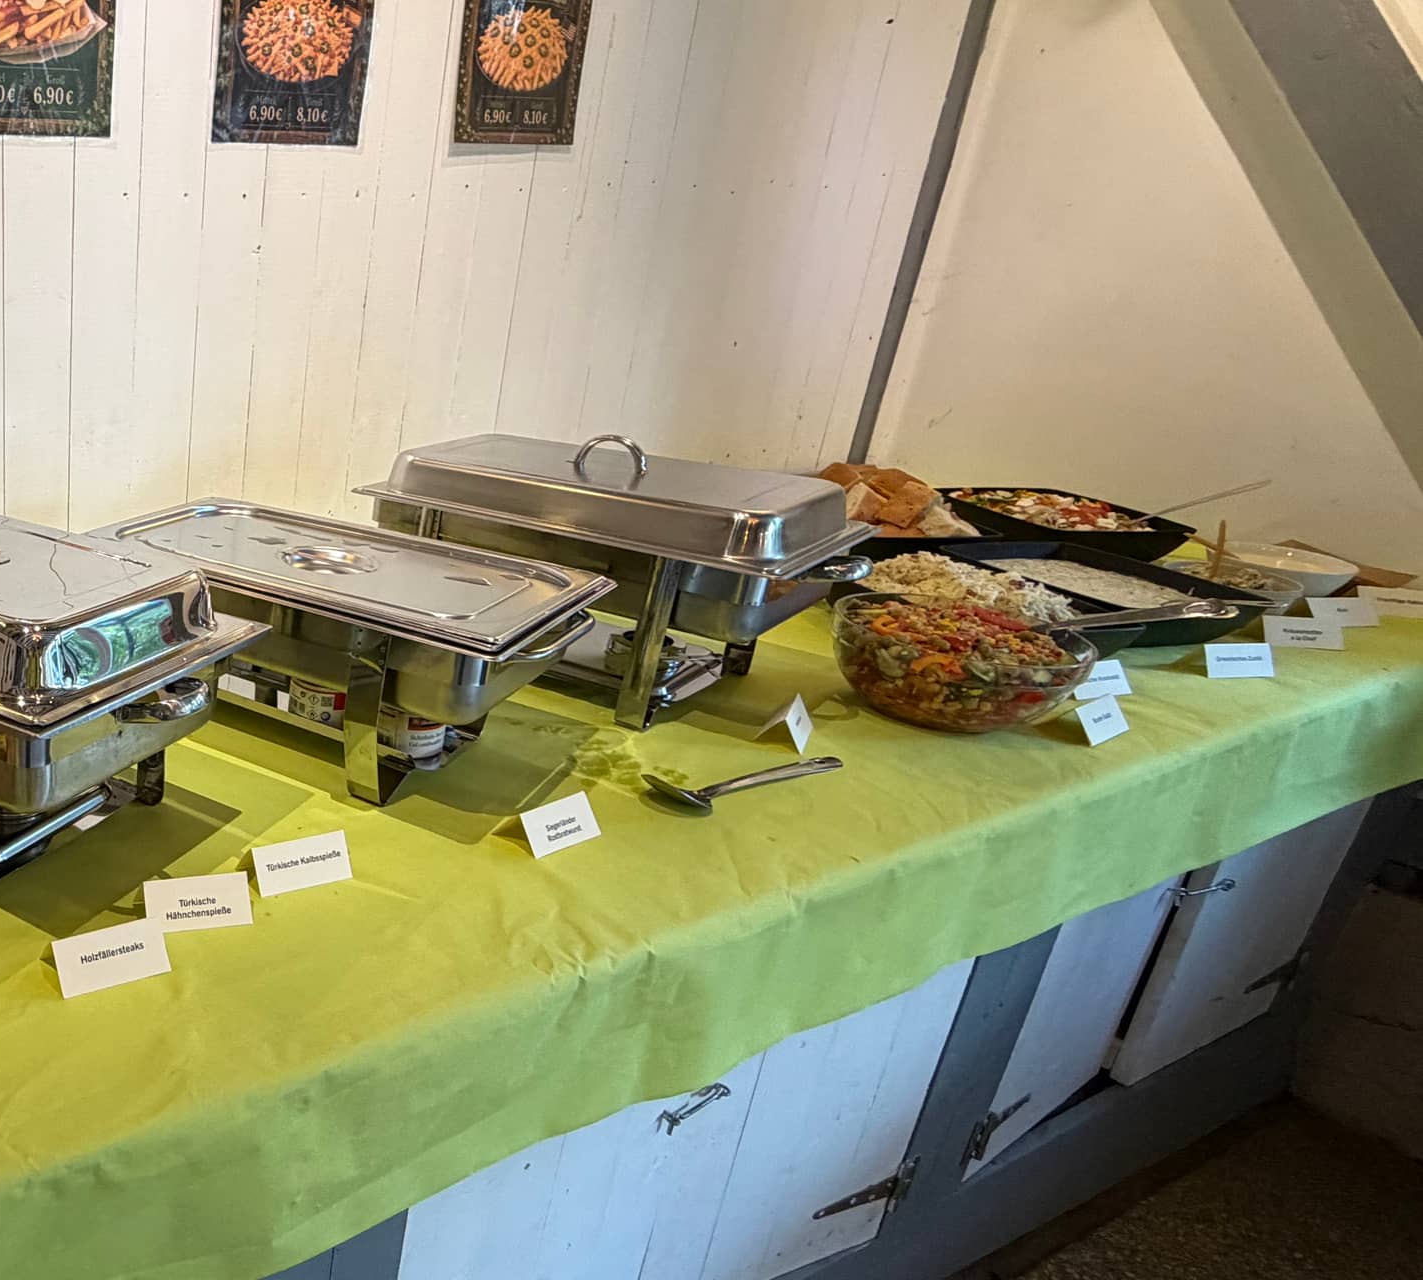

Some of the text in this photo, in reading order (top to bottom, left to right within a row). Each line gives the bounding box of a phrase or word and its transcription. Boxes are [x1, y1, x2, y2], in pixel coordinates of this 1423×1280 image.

[266, 849, 342, 873] Türkische Kalbsspieße
[178, 895, 216, 908] Türkische
[165, 906, 232, 921] Hähnchenspieße
[80, 941, 145, 965] Holzfällersteaks
